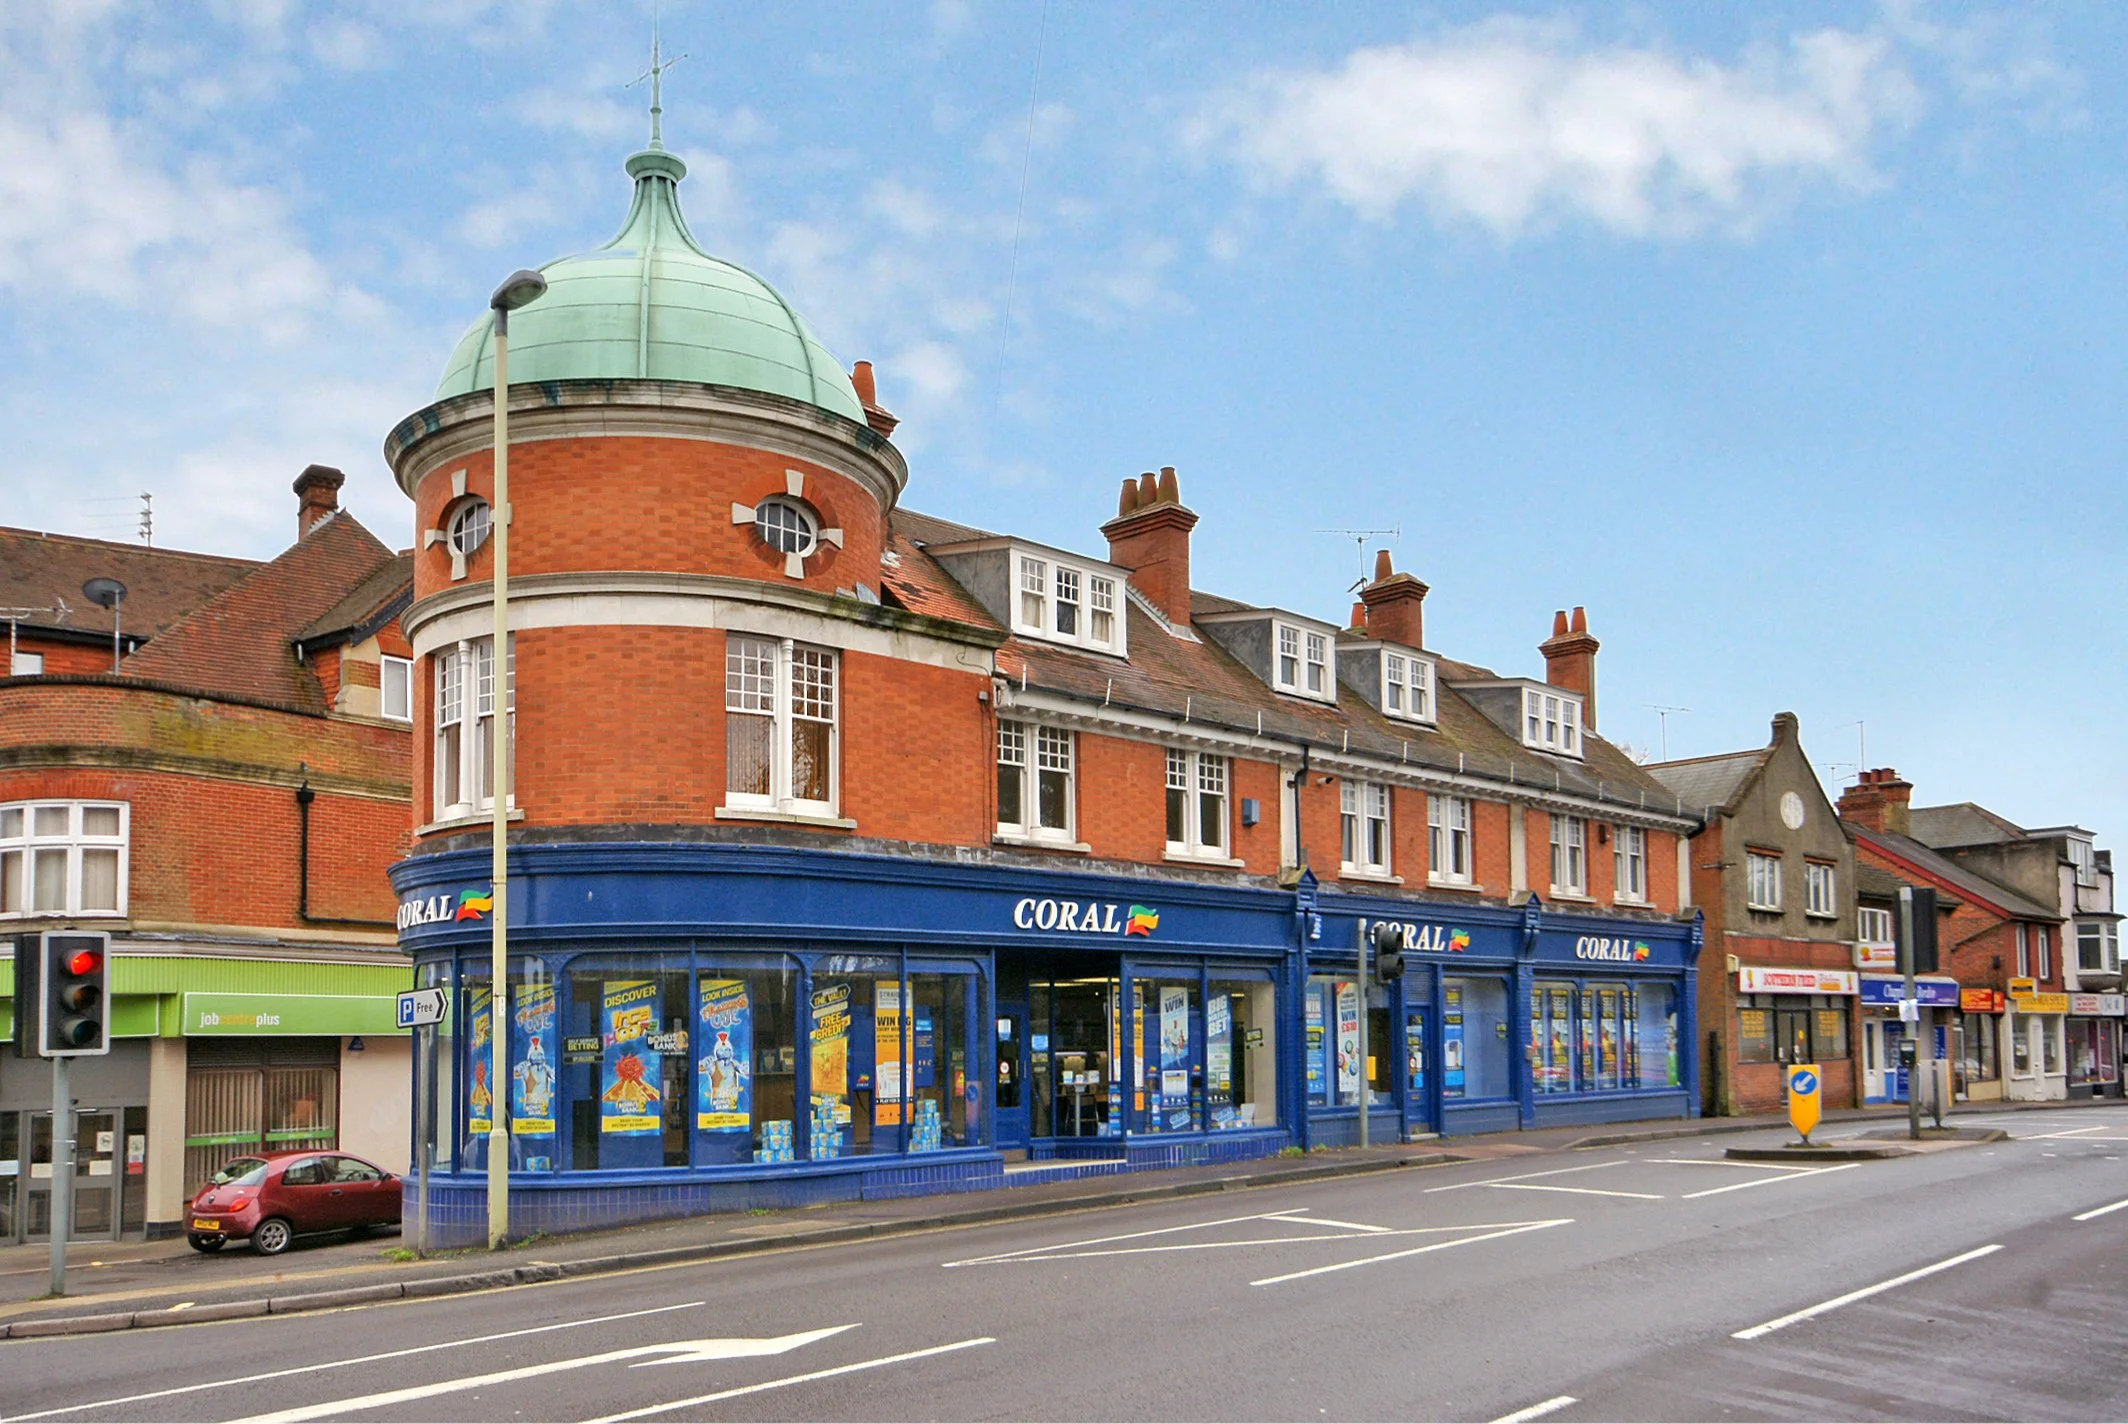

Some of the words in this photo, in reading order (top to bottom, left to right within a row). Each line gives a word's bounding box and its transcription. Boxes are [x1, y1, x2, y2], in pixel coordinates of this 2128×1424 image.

[1014, 898, 1121, 933] CORAL
[1576, 936, 1631, 961] CORAL
[604, 985, 657, 1008] DISCOVER
[702, 991, 721, 1002] LOOK
[722, 984, 745, 998] INSIDE
[417, 1002, 433, 1013] Free
[1165, 997, 1185, 1013] WIN
[1208, 994, 1227, 1014] BIG
[200, 1012, 280, 1028] jobcentreplus
[820, 1012, 842, 1028] FREE
[877, 1016, 896, 1026] WIN
[1341, 1010, 1357, 1022] WIN
[816, 1023, 846, 1039] CREDIT
[1209, 1020, 1227, 1037] BET
[568, 1042, 598, 1051] BETTING
